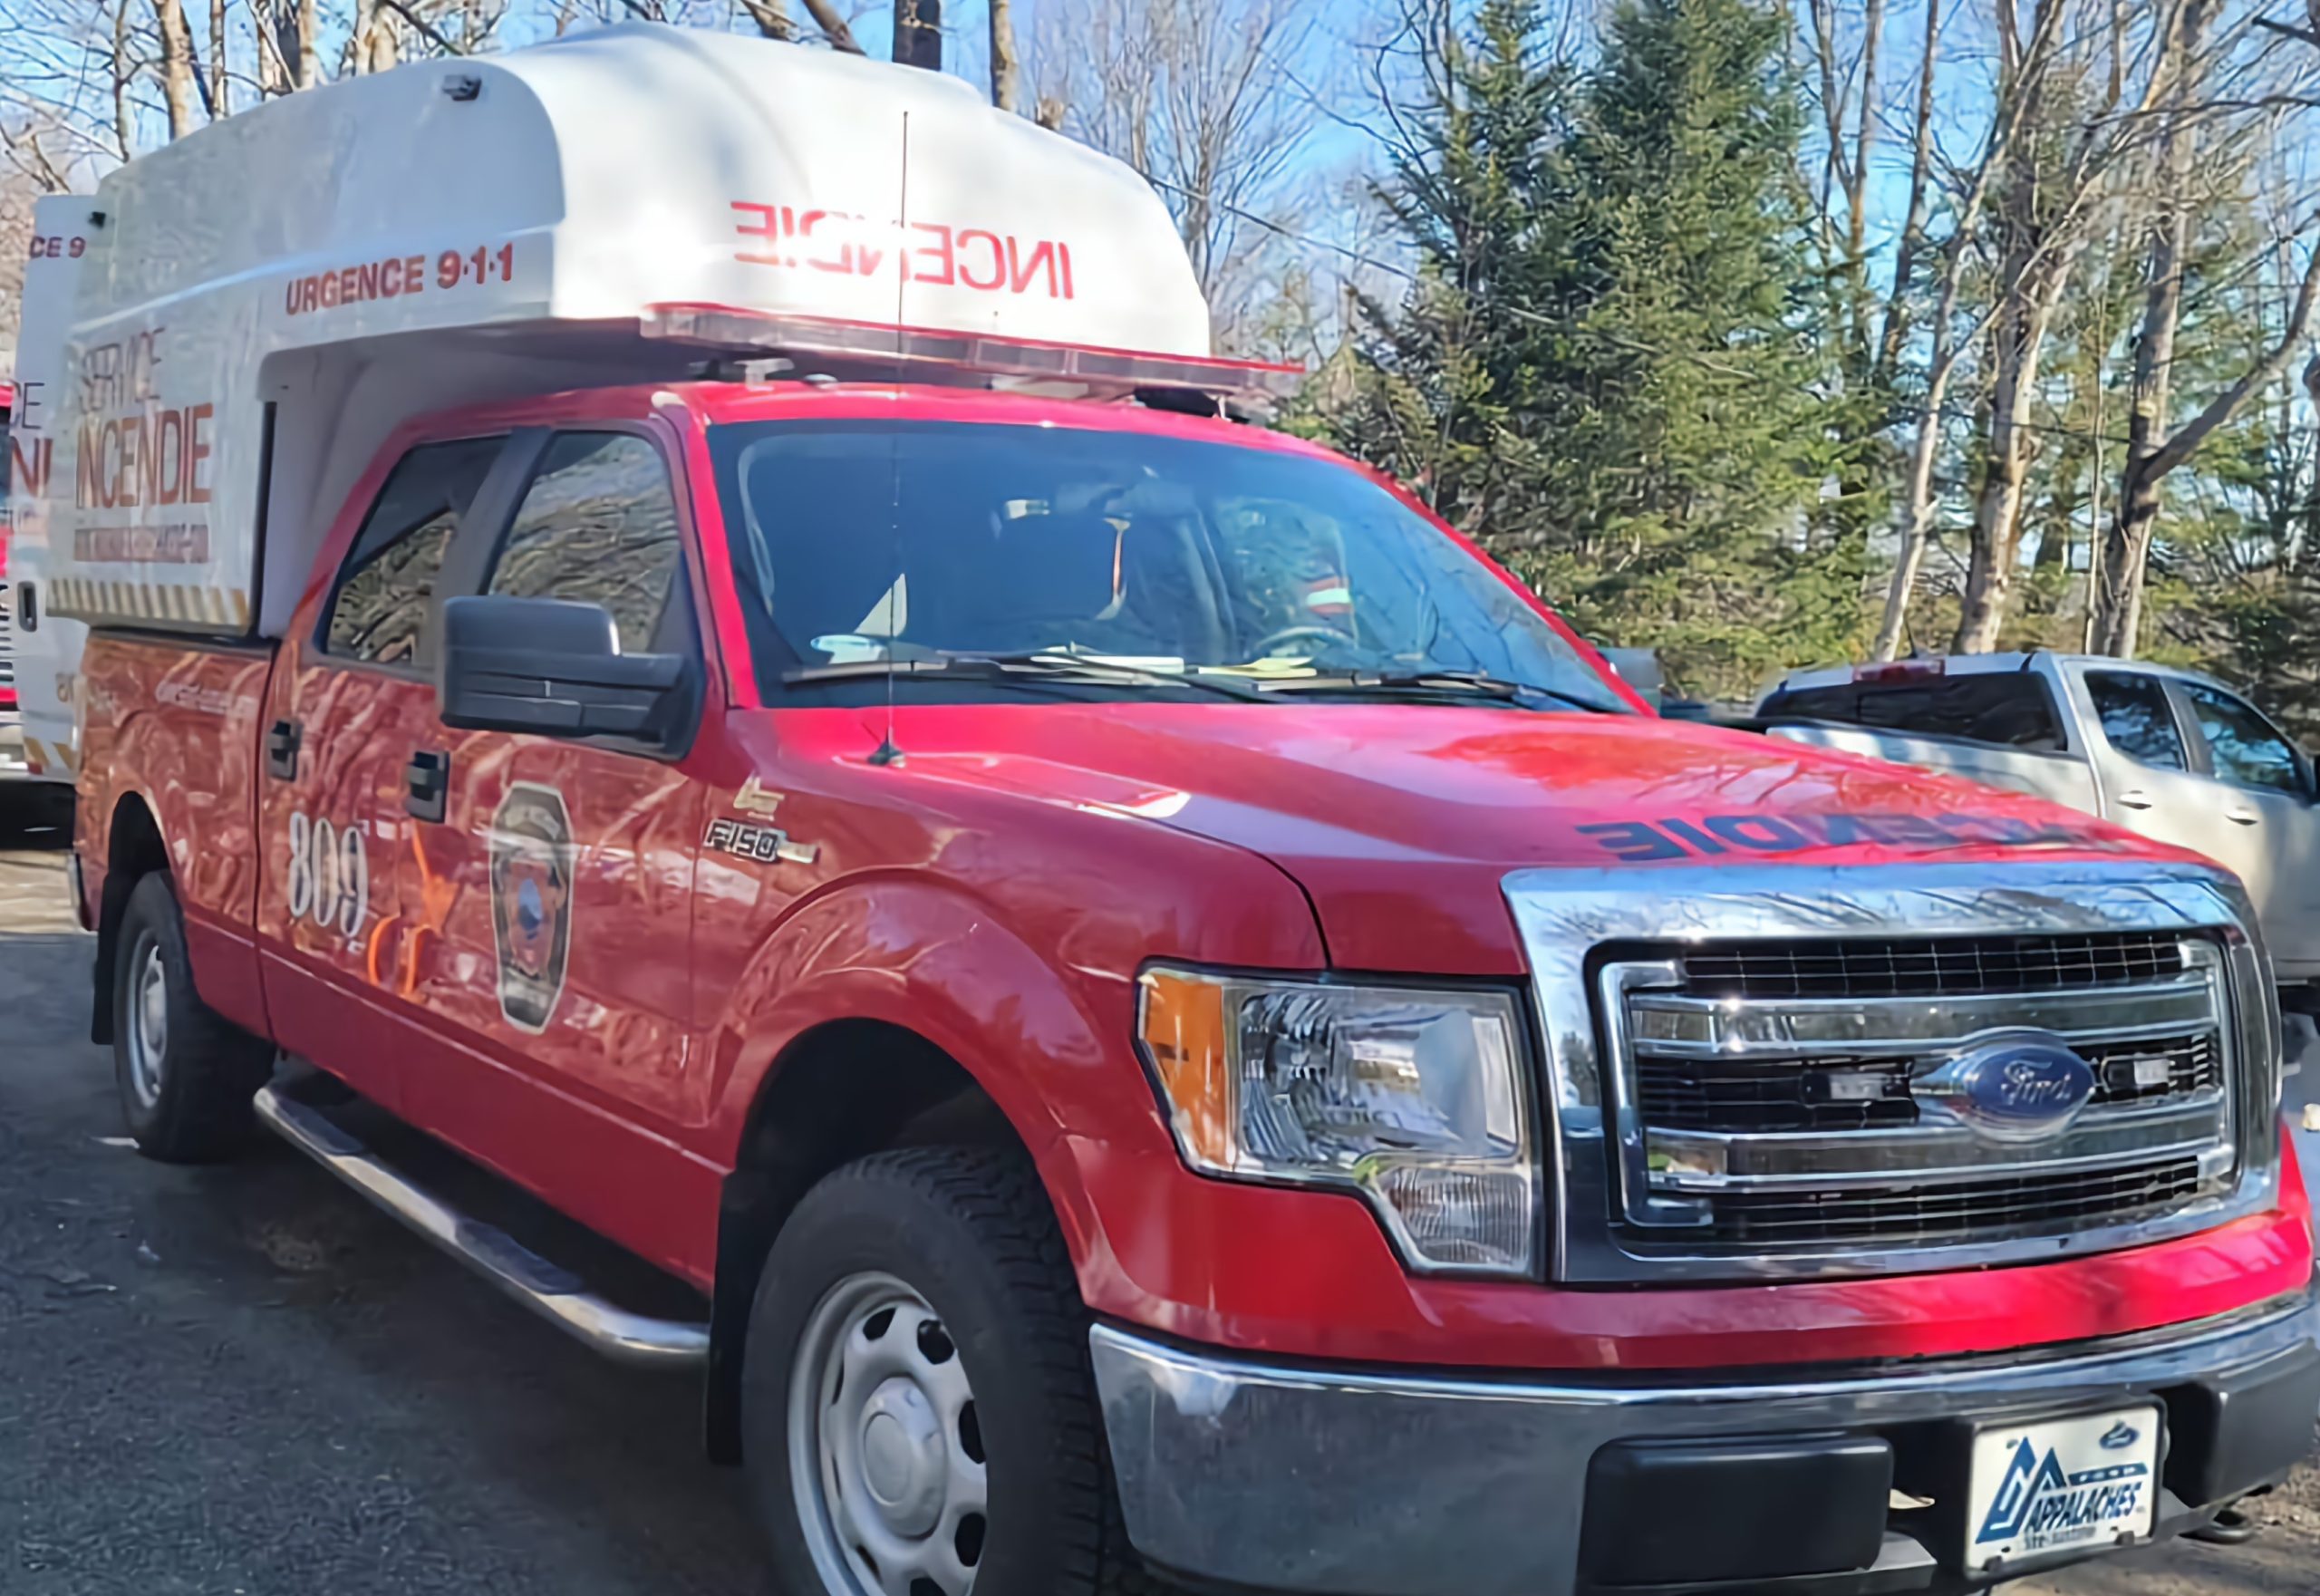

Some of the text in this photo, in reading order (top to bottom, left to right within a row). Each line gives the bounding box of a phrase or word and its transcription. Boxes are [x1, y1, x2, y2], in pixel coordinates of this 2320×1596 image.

[286, 255, 426, 315] URGENCE
[76, 402, 213, 509] INCENDIE
[289, 811, 369, 938] 809
[2001, 1059, 2073, 1107] Ford
[2025, 1481, 2143, 1533] APPALACHES
